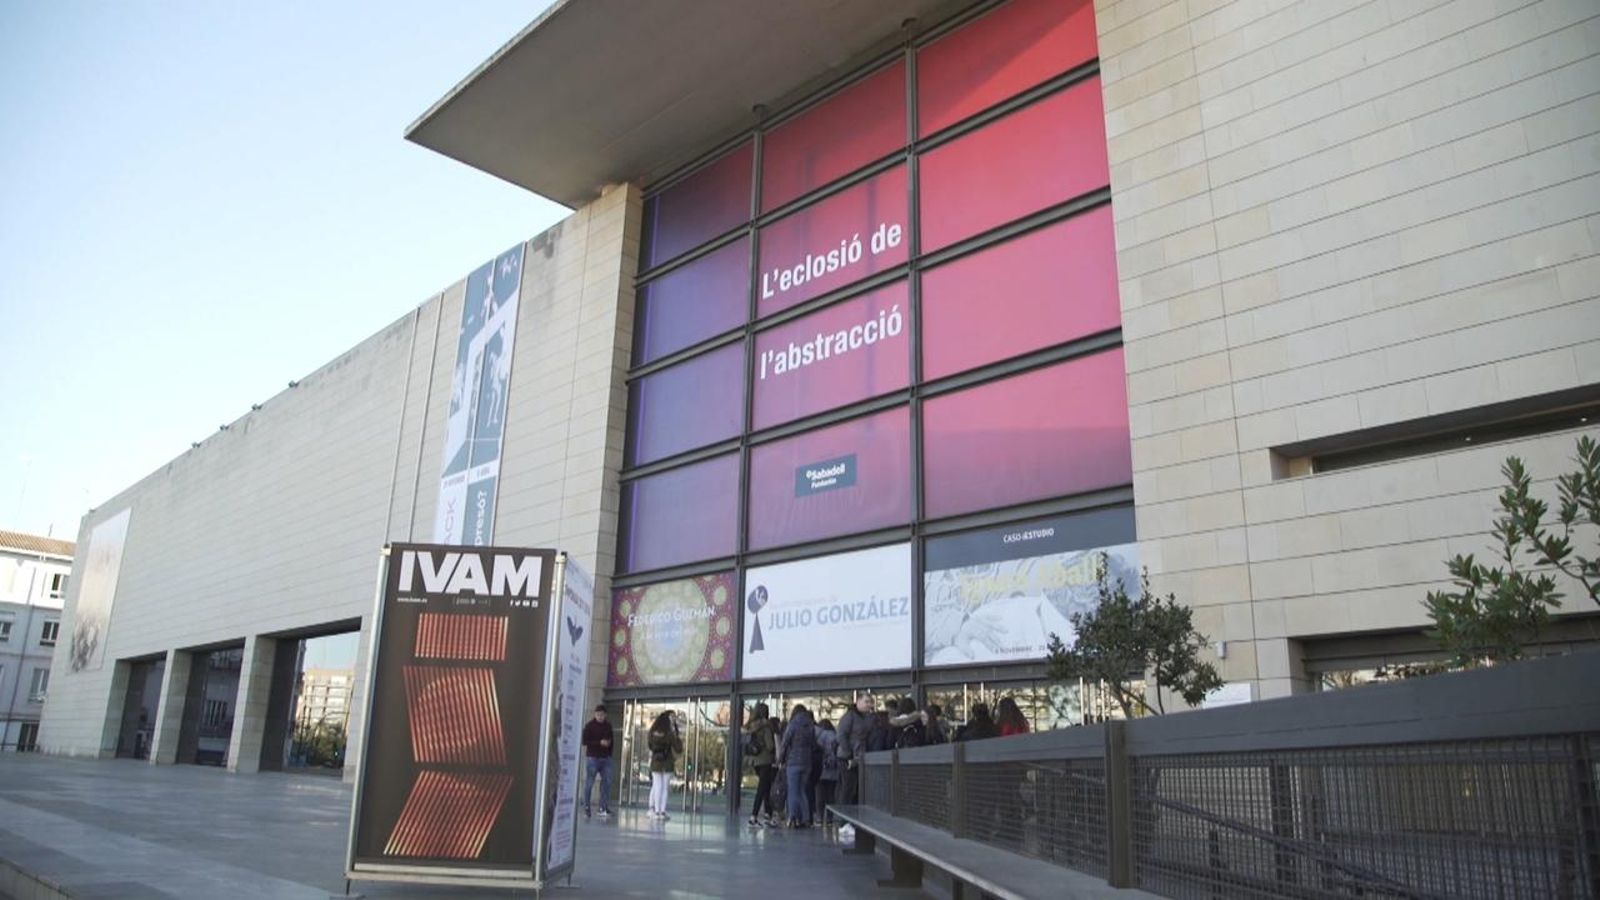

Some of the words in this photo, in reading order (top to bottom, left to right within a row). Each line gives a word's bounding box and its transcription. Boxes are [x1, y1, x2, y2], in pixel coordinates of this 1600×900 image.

[762, 233, 862, 299] L'eclosió
[871, 223, 901, 254] de
[760, 305, 902, 379] l'abstracció
[398, 551, 542, 597] IVAM
[769, 608, 812, 630] JULIO
[817, 595, 909, 625] GONZÁLEZ
